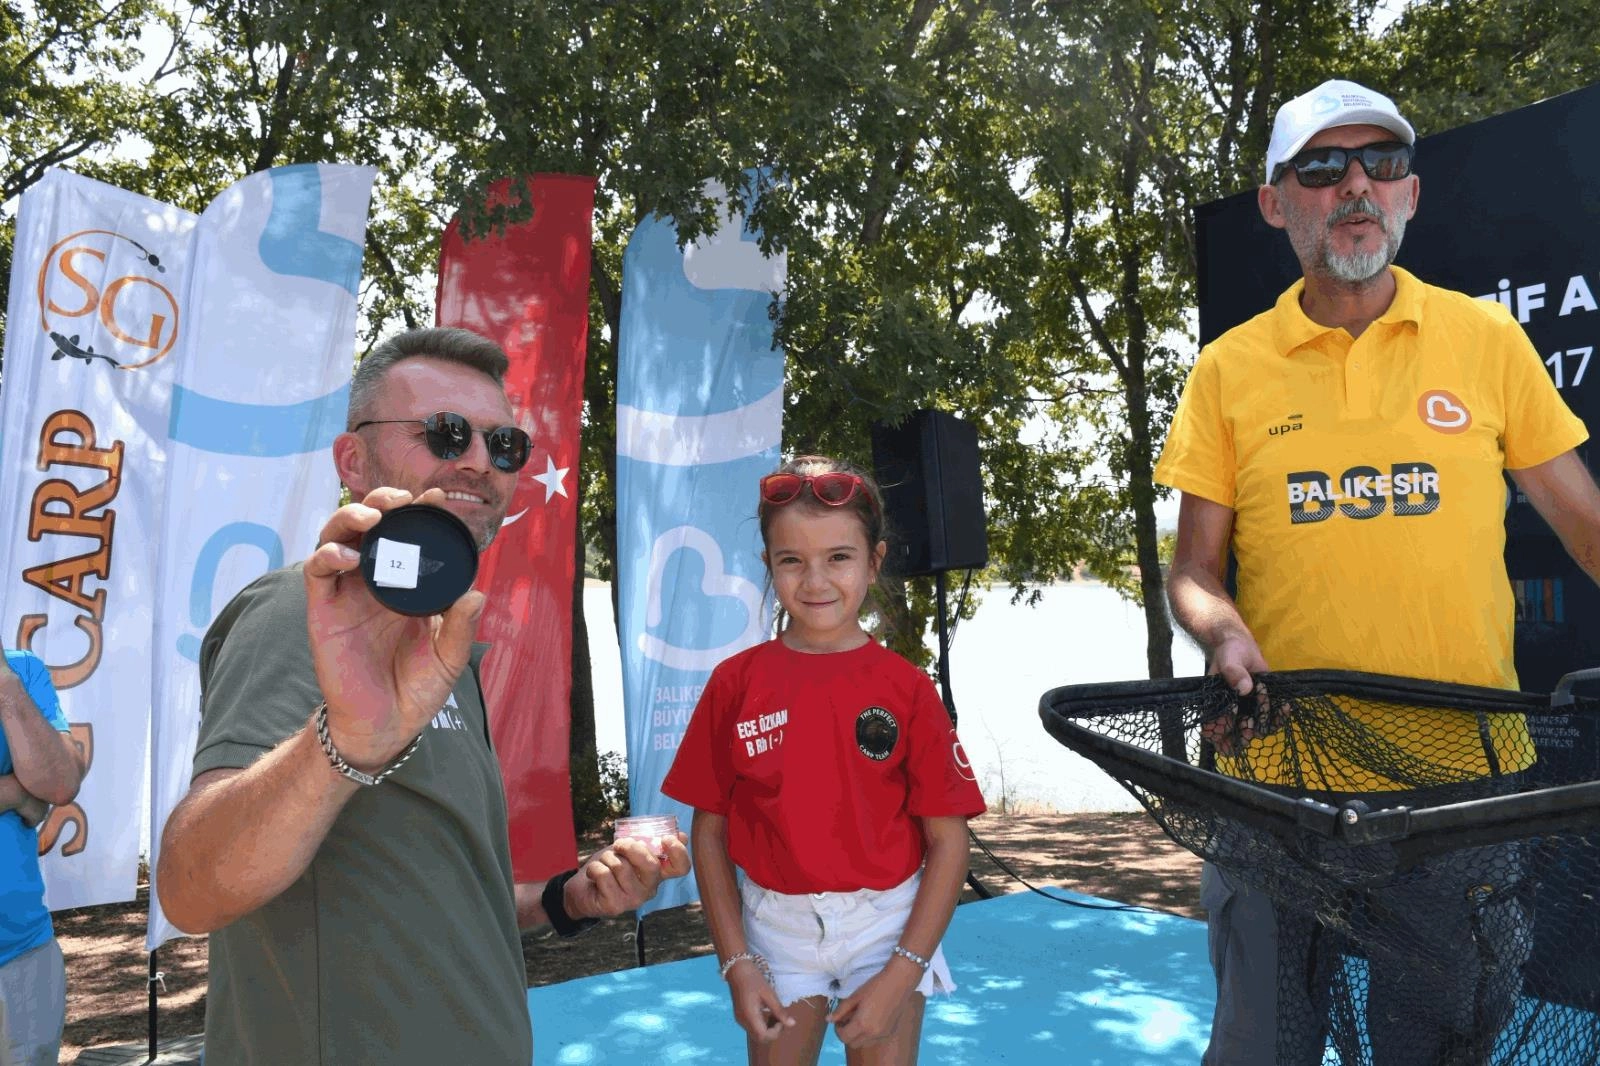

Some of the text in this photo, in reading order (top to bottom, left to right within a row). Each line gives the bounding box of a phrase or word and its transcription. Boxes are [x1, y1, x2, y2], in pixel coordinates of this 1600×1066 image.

[1473, 278, 1546, 324] İF
[1268, 421, 1303, 437] upa
[1288, 466, 1440, 504] BALIKESİR
[655, 684, 703, 704] BALIKE
[736, 709, 788, 739] ECE ÖZKAN
[860, 708, 897, 728] THE PERFECT
[654, 732, 683, 752] BEL
[745, 741, 755, 758] B
[875, 750, 890, 760] TEAM
